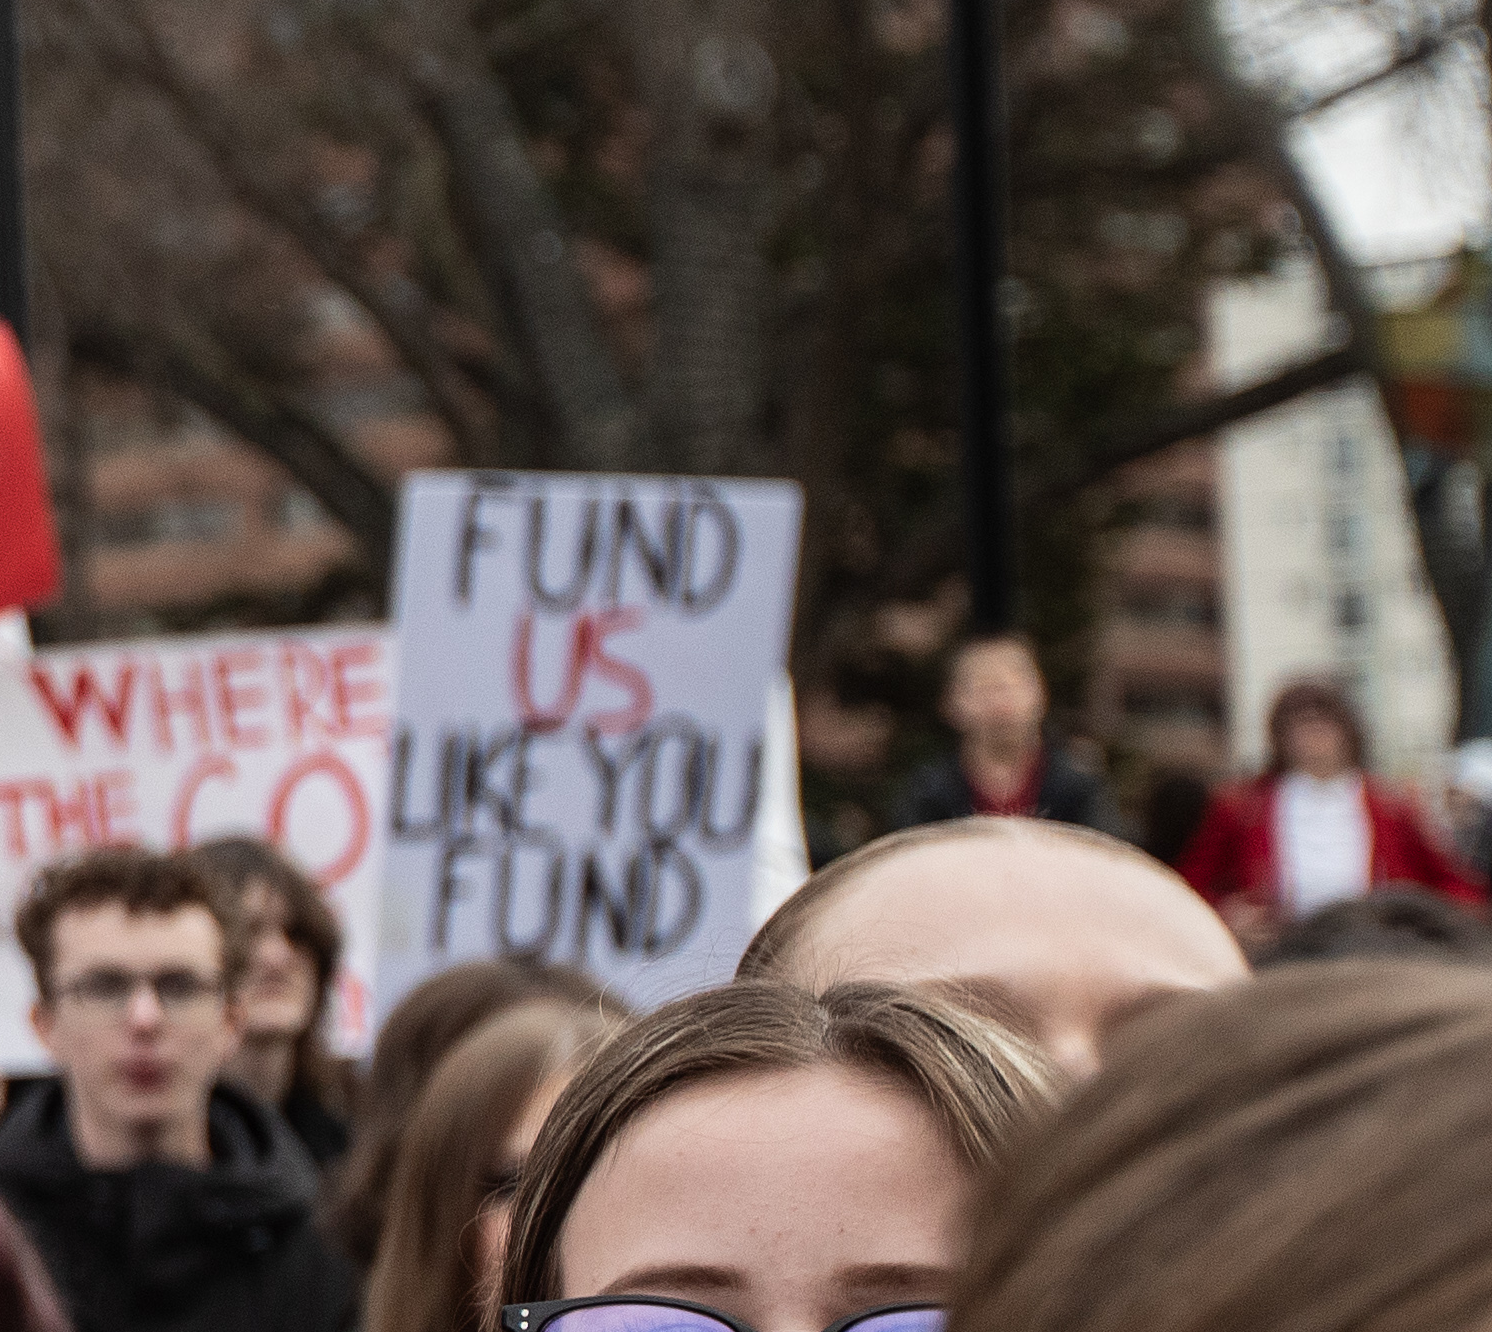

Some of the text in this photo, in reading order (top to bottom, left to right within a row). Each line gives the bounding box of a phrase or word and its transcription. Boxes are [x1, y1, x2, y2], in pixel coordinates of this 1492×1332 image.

[454, 470, 744, 615] FUND
[30, 639, 389, 751] WHERE
[511, 605, 655, 734] US
[391, 713, 765, 851] LIKE YOU
[430, 833, 705, 967] FUND
